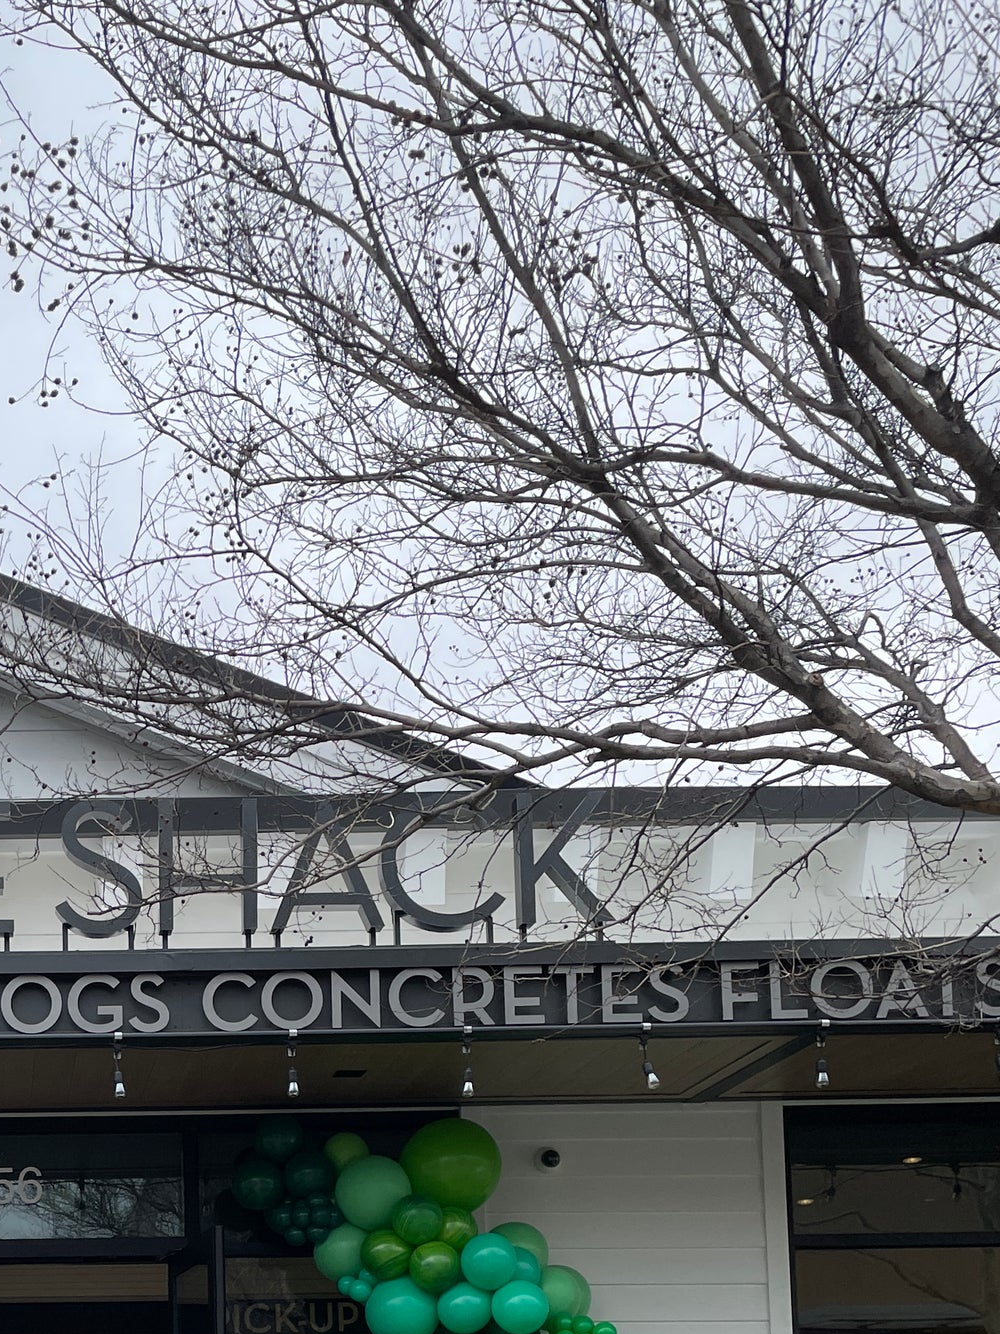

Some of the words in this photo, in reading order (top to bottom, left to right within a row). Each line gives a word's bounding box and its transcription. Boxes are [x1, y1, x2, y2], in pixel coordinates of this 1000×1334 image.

[55, 791, 614, 938] SHACK
[202, 963, 690, 1032] CONCRETES
[226, 1302, 359, 1333] ICK-UP
